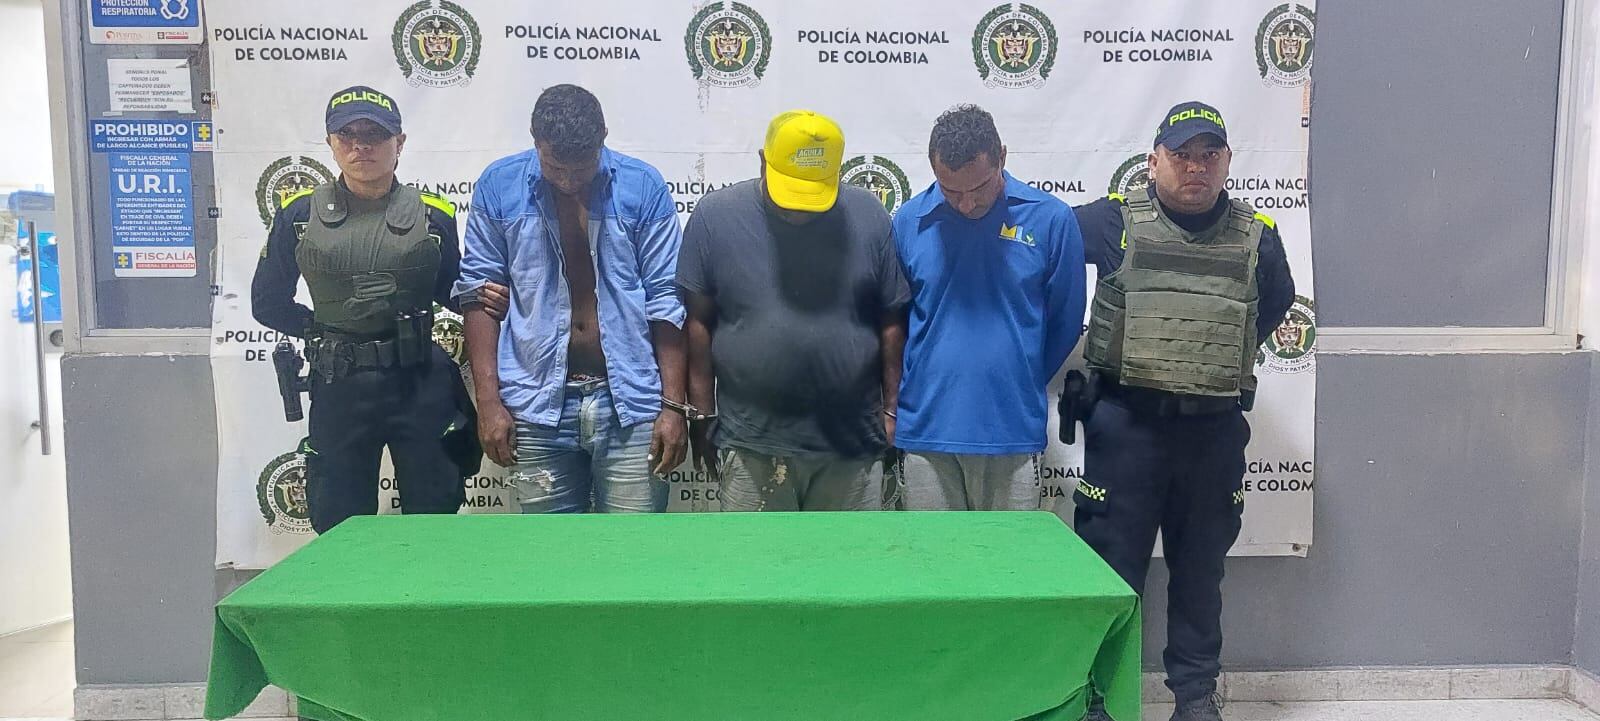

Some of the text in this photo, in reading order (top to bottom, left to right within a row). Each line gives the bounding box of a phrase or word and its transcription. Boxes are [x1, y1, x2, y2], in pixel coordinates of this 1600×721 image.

[102, 8, 157, 16] RESPIRATORIA
[215, 24, 368, 40] POLICÍA NACIONAL
[506, 24, 661, 41] POLICÍA NACIONAL
[799, 28, 949, 44] POLICÍA NACIONAL
[1084, 27, 1233, 43] POLICÍA NACIONAL
[236, 48, 347, 60] DE COLOMBIA
[527, 46, 640, 59] DE COLOMBIA
[819, 51, 928, 63] DE COLOMBIA
[1104, 49, 1212, 62] DE COLOMBIA
[331, 91, 392, 111] POLICÍA
[1169, 108, 1224, 128] POLICÍA
[95, 124, 187, 135] PROHIBIDO
[310, 170, 325, 184] COLO
[1225, 175, 1306, 190] OLICÍA NACI
[118, 174, 182, 193] U.R.I.
[436, 182, 474, 194] NACI
[676, 202, 694, 213] DE
[1255, 197, 1307, 208] COLOM
[246, 350, 266, 361] DE
[1044, 467, 1083, 478] ONAL
[1245, 480, 1314, 492] E COLOM
[681, 490, 700, 500] DE
[463, 496, 504, 507] MBIA
